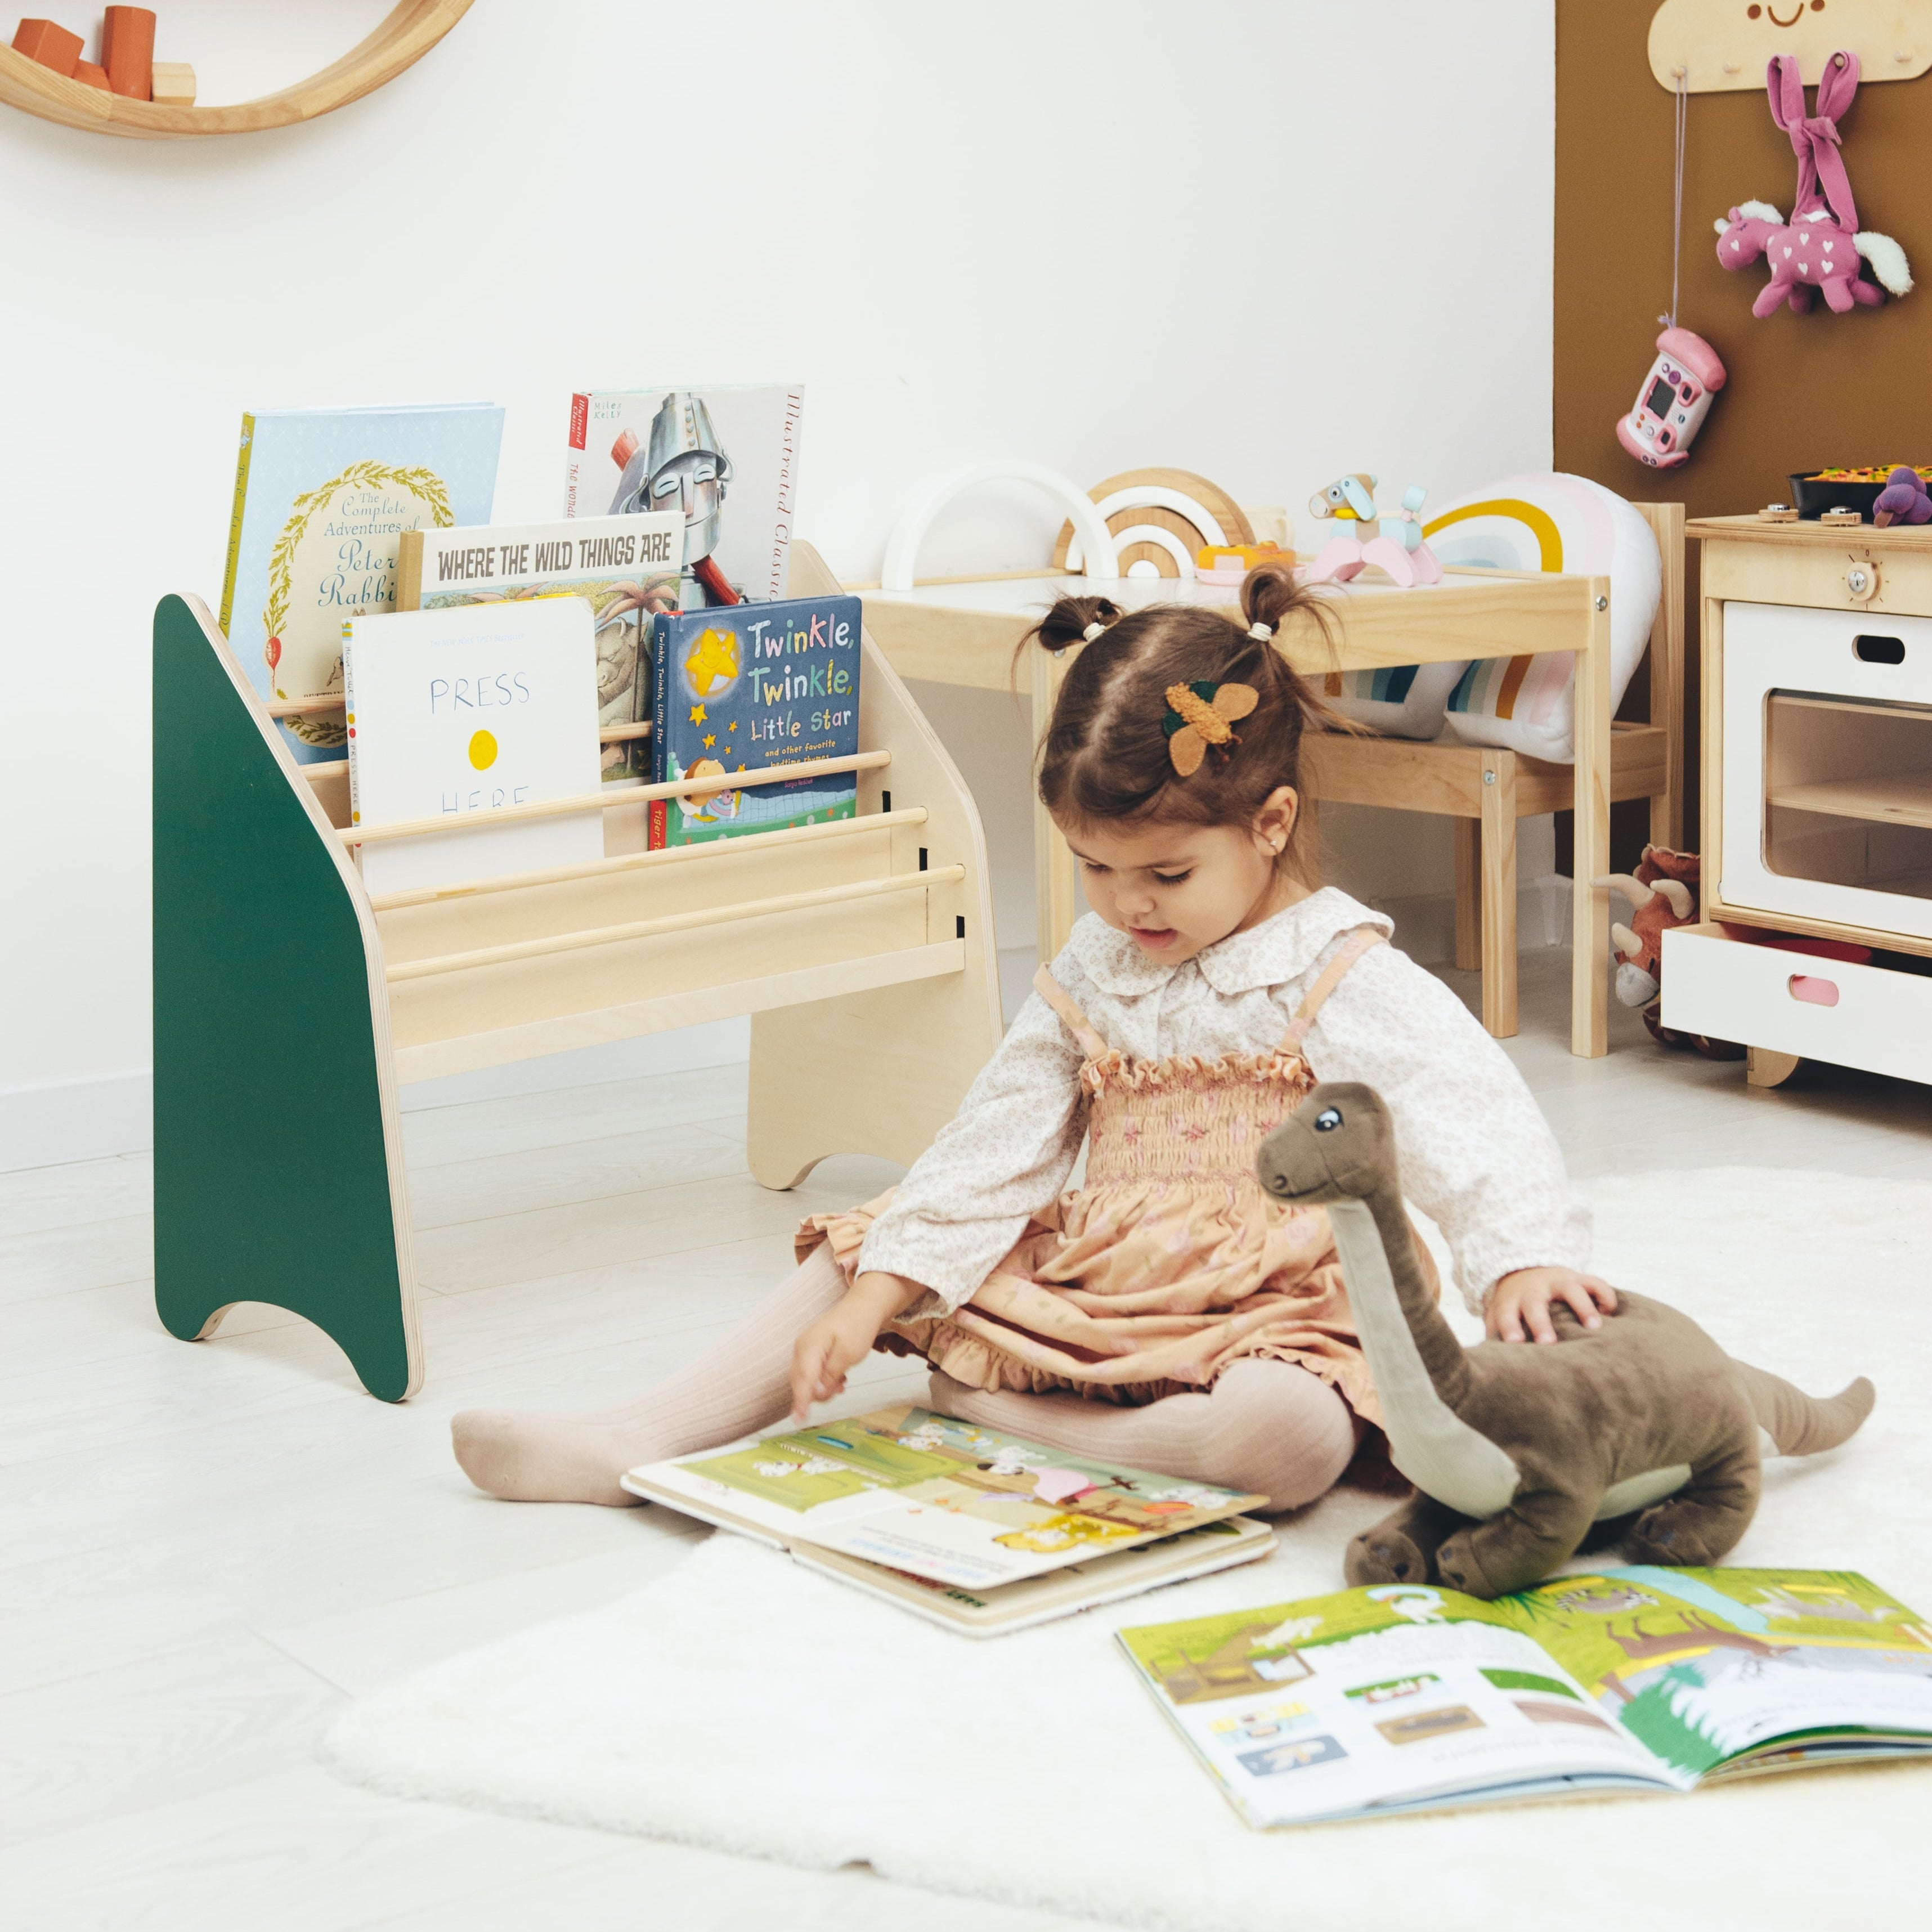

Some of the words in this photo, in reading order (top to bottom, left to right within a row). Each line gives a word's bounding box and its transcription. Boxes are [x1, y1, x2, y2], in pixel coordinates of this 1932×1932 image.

[576, 399, 585, 445] Illustrated
[594, 401, 621, 410] Miles
[777, 393, 800, 514] Illustrated
[342, 496, 407, 522] Complete
[360, 492, 379, 503] The
[324, 522, 401, 536] Adventures
[405, 516, 420, 531] of
[337, 539, 399, 572] Peter
[438, 547, 495, 581] WHERE
[500, 544, 530, 575] THE
[535, 541, 572, 572] WILD
[579, 535, 635, 568] THINGS
[640, 532, 671, 563] ARE
[318, 573, 397, 607] Rabbi
[747, 613, 854, 658] Twinkle,
[431, 672, 529, 714] PRESS
[748, 658, 853, 706] Twinkle,
[751, 710, 801, 741] Little
[765, 747, 779, 756] and
[782, 746, 802, 754] other
[805, 739, 836, 751] favorite
